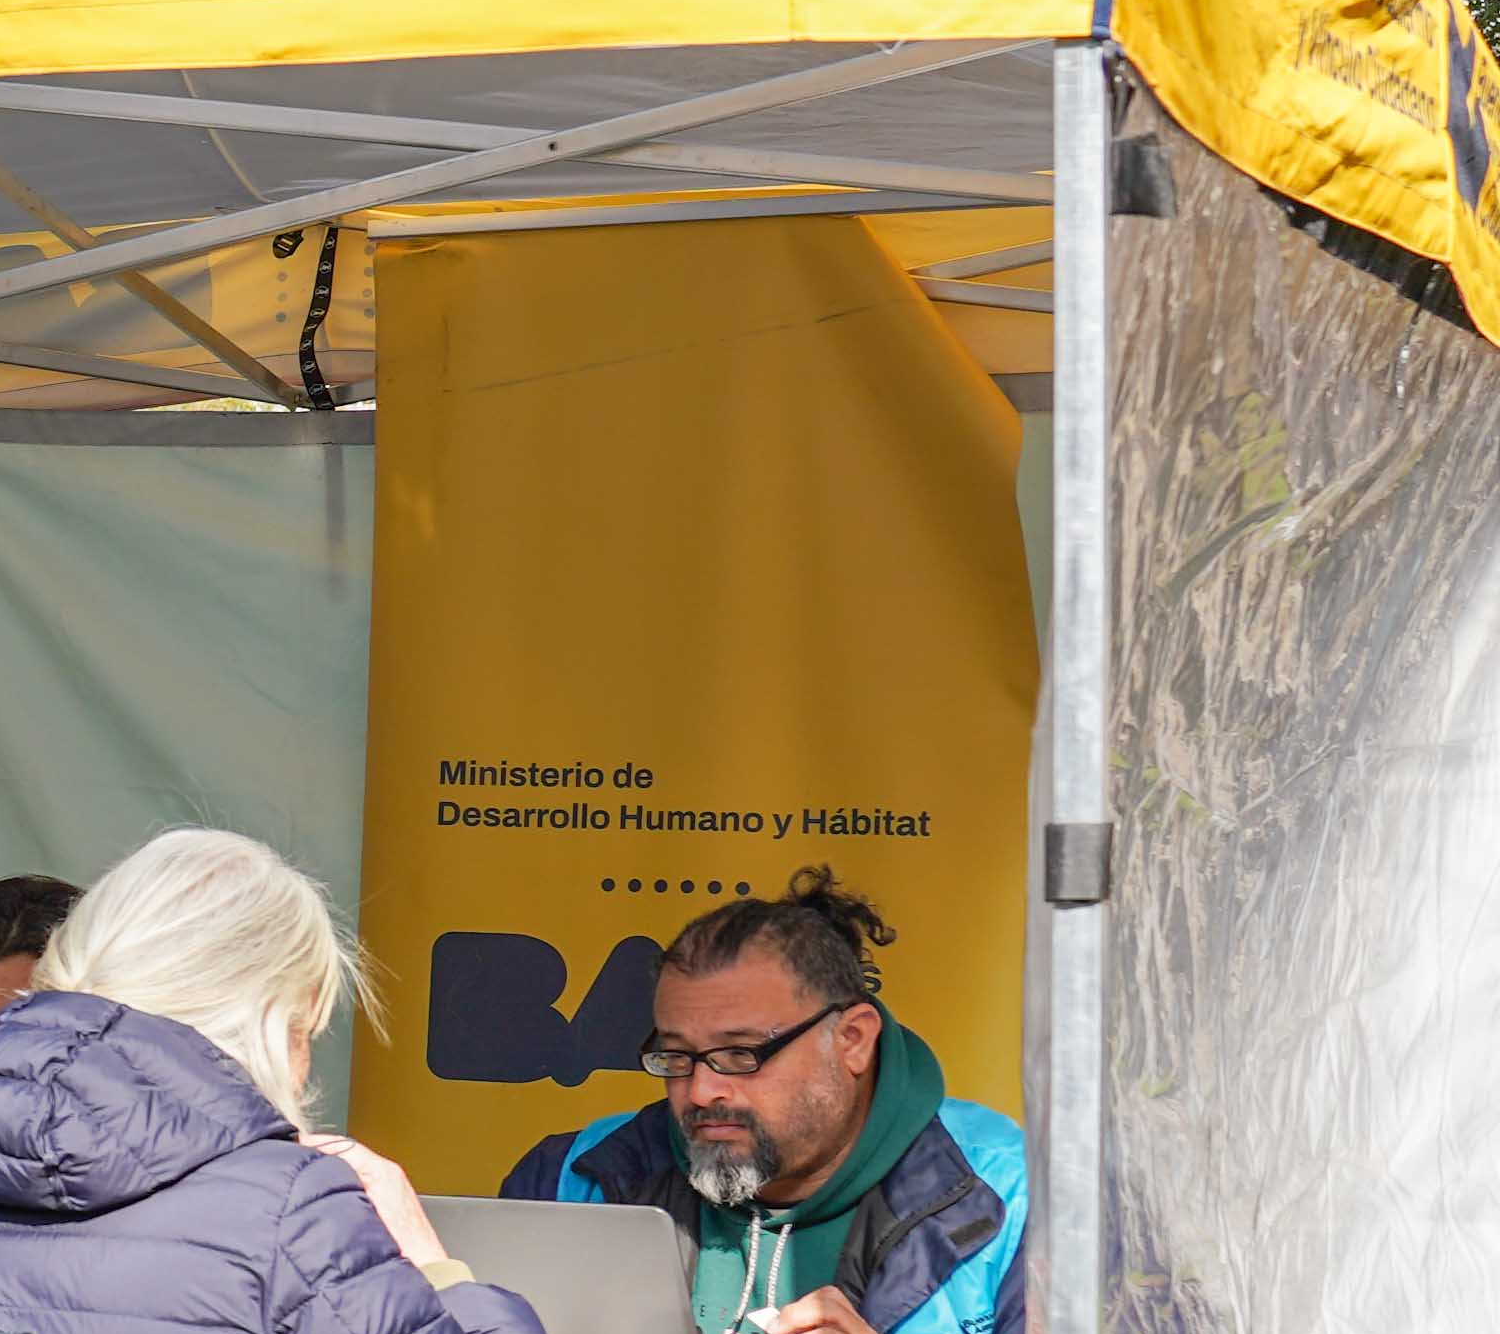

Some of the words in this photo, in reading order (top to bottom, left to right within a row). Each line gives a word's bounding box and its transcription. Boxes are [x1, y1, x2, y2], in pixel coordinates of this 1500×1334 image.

[439, 761, 604, 789] Ministerio
[612, 762, 654, 789] de
[436, 801, 610, 830] Desarrollo
[619, 804, 763, 833] Humano
[772, 811, 793, 840] y
[802, 807, 931, 837] Hábitat
